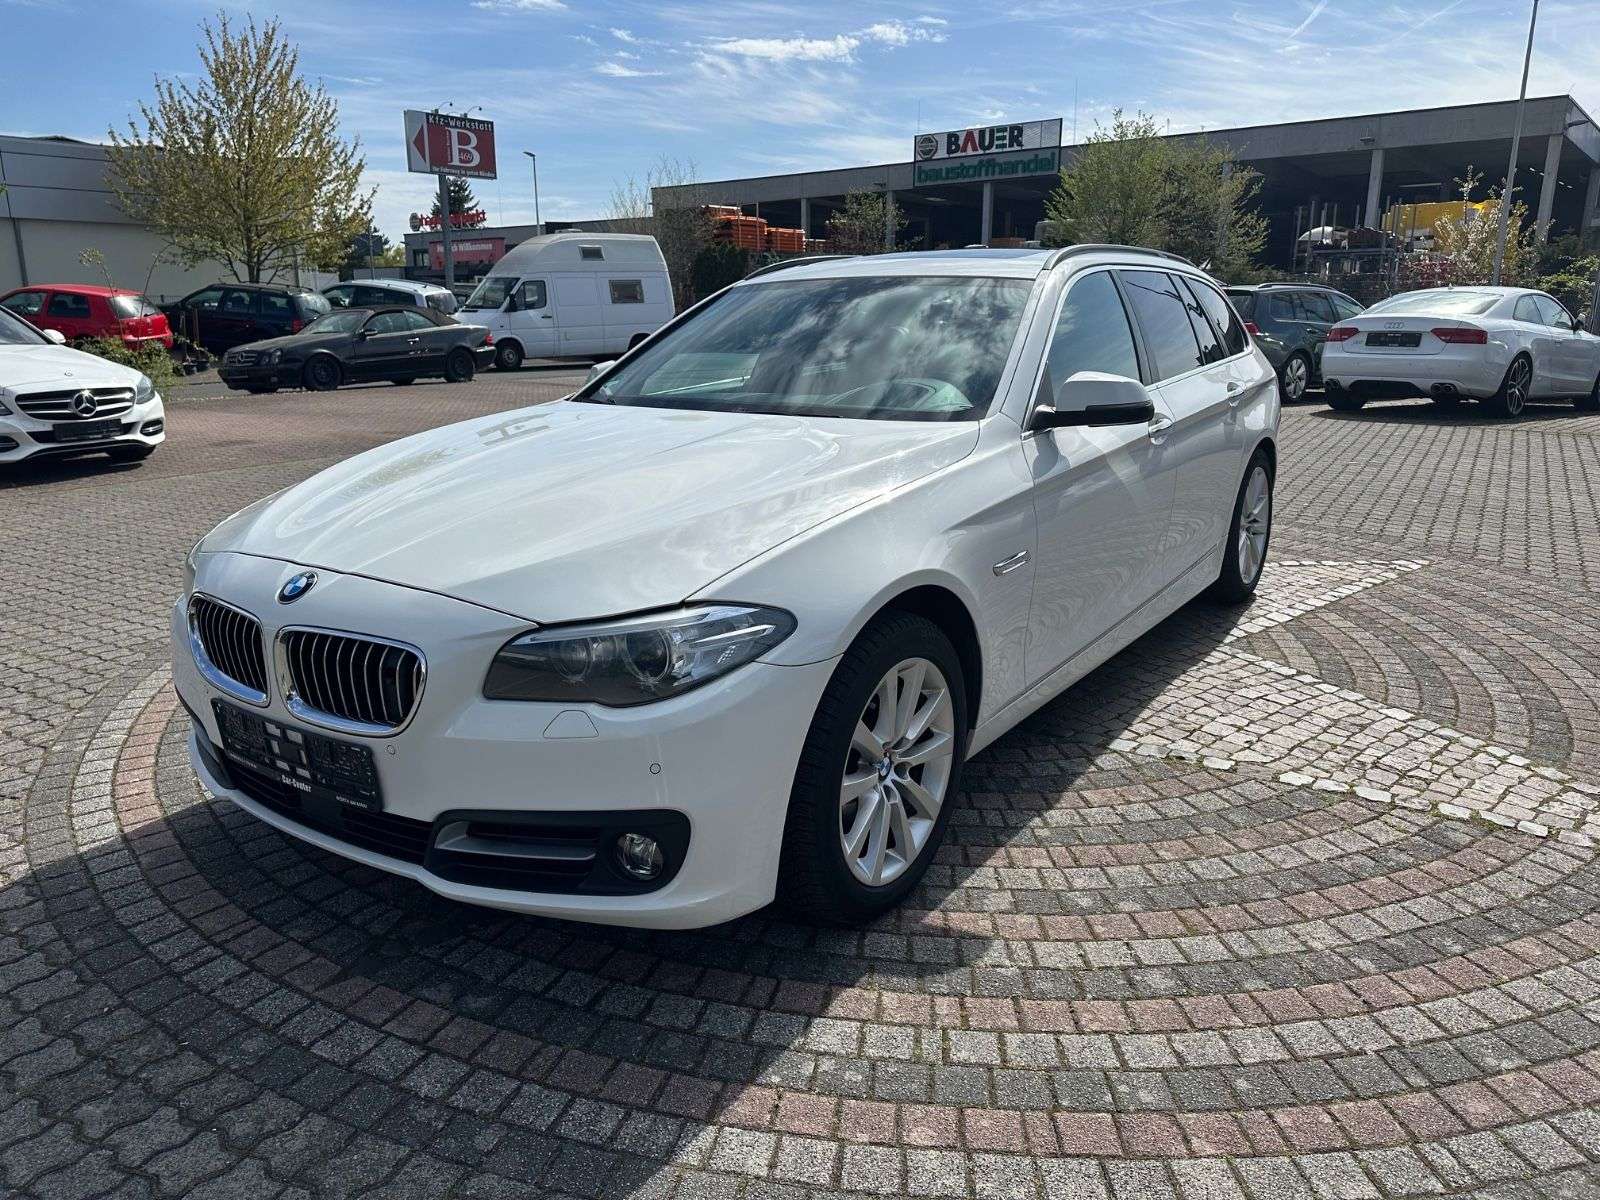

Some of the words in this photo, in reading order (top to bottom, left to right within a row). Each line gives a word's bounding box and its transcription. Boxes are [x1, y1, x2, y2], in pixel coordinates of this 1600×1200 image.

[428, 115, 492, 131] Kfz-Werkstatt
[445, 127, 480, 167] B
[946, 125, 1023, 154] BAUER
[917, 153, 1056, 182] baustoffhandel
